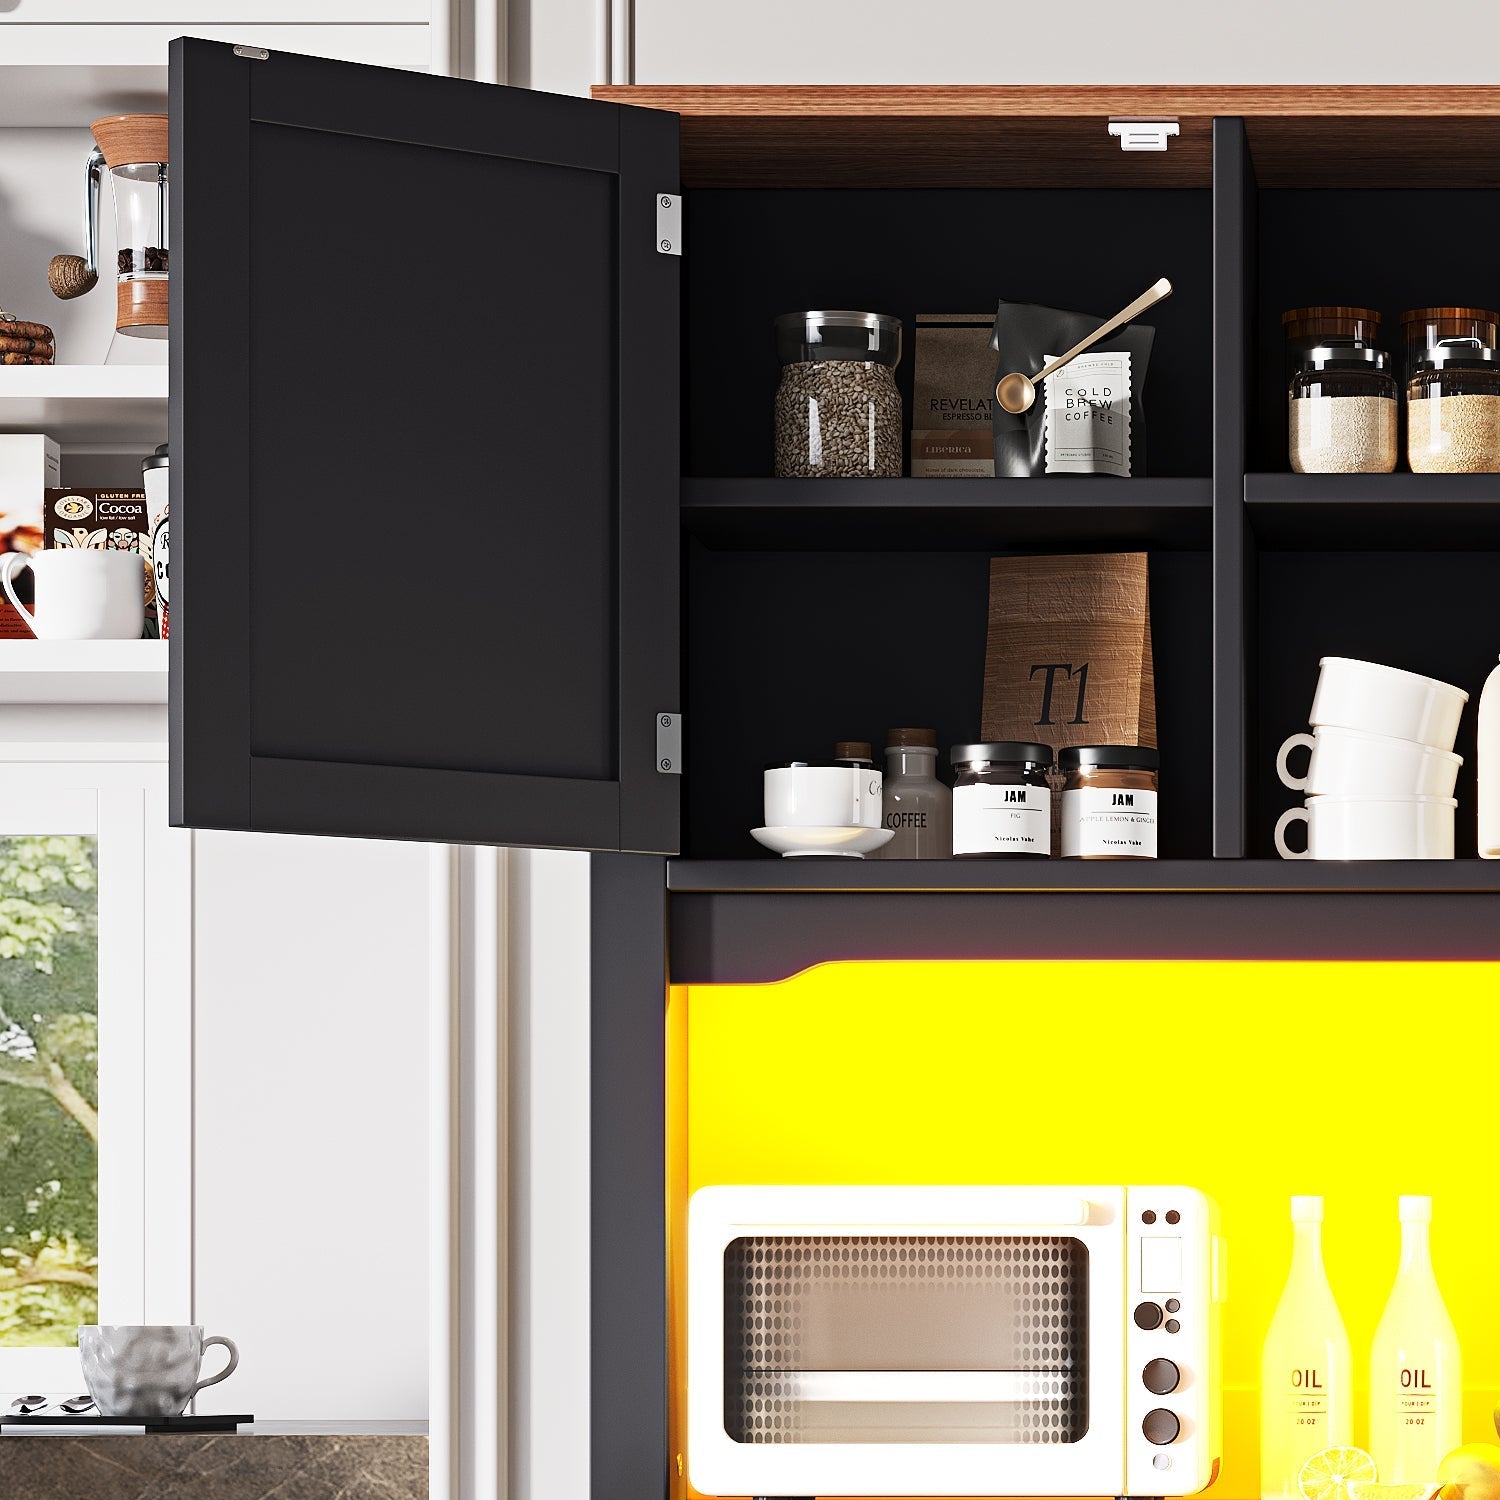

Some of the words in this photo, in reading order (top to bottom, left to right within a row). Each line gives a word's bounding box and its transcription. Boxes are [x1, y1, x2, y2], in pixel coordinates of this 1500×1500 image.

[1065, 387, 1112, 396] COLD
[930, 398, 993, 411] REVELAT
[1066, 398, 1113, 410] BREW
[942, 412, 982, 421] ESPRESSO
[1065, 411, 1113, 424] COFFEE
[99, 502, 142, 514] Cocoa
[1029, 662, 1090, 726] T1
[1004, 790, 1026, 802] JAM
[1112, 794, 1134, 806] JAM
[887, 812, 927, 828] COFFEE
[1292, 1369, 1322, 1388] OIL
[1400, 1369, 1431, 1388] OIL
